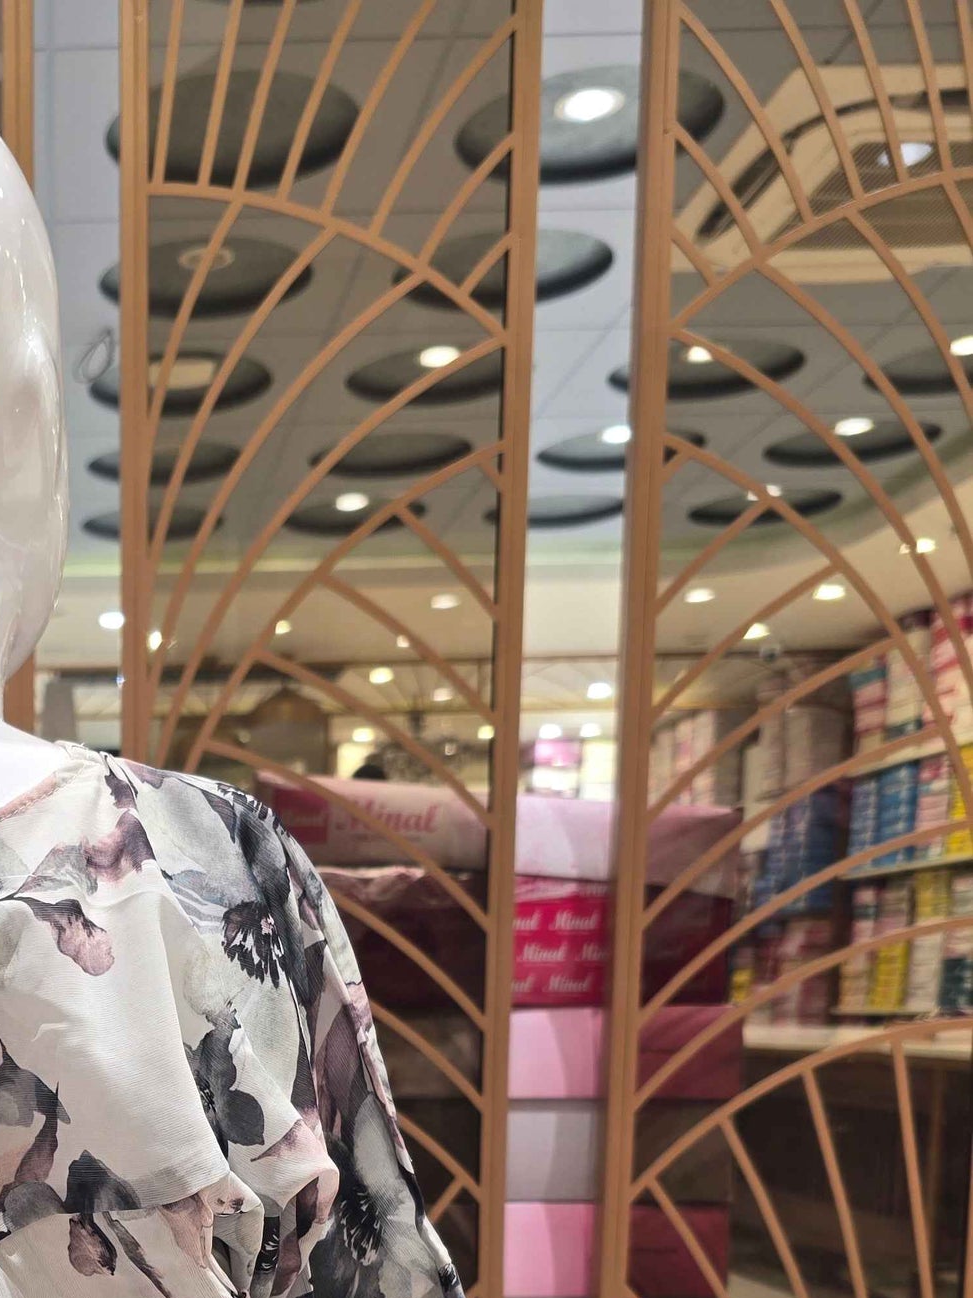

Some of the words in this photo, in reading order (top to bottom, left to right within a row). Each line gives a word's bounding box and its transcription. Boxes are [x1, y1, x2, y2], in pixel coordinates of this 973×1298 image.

[548, 909, 599, 932] Minal
[515, 942, 569, 962] Minal
[542, 973, 596, 993] Minal
